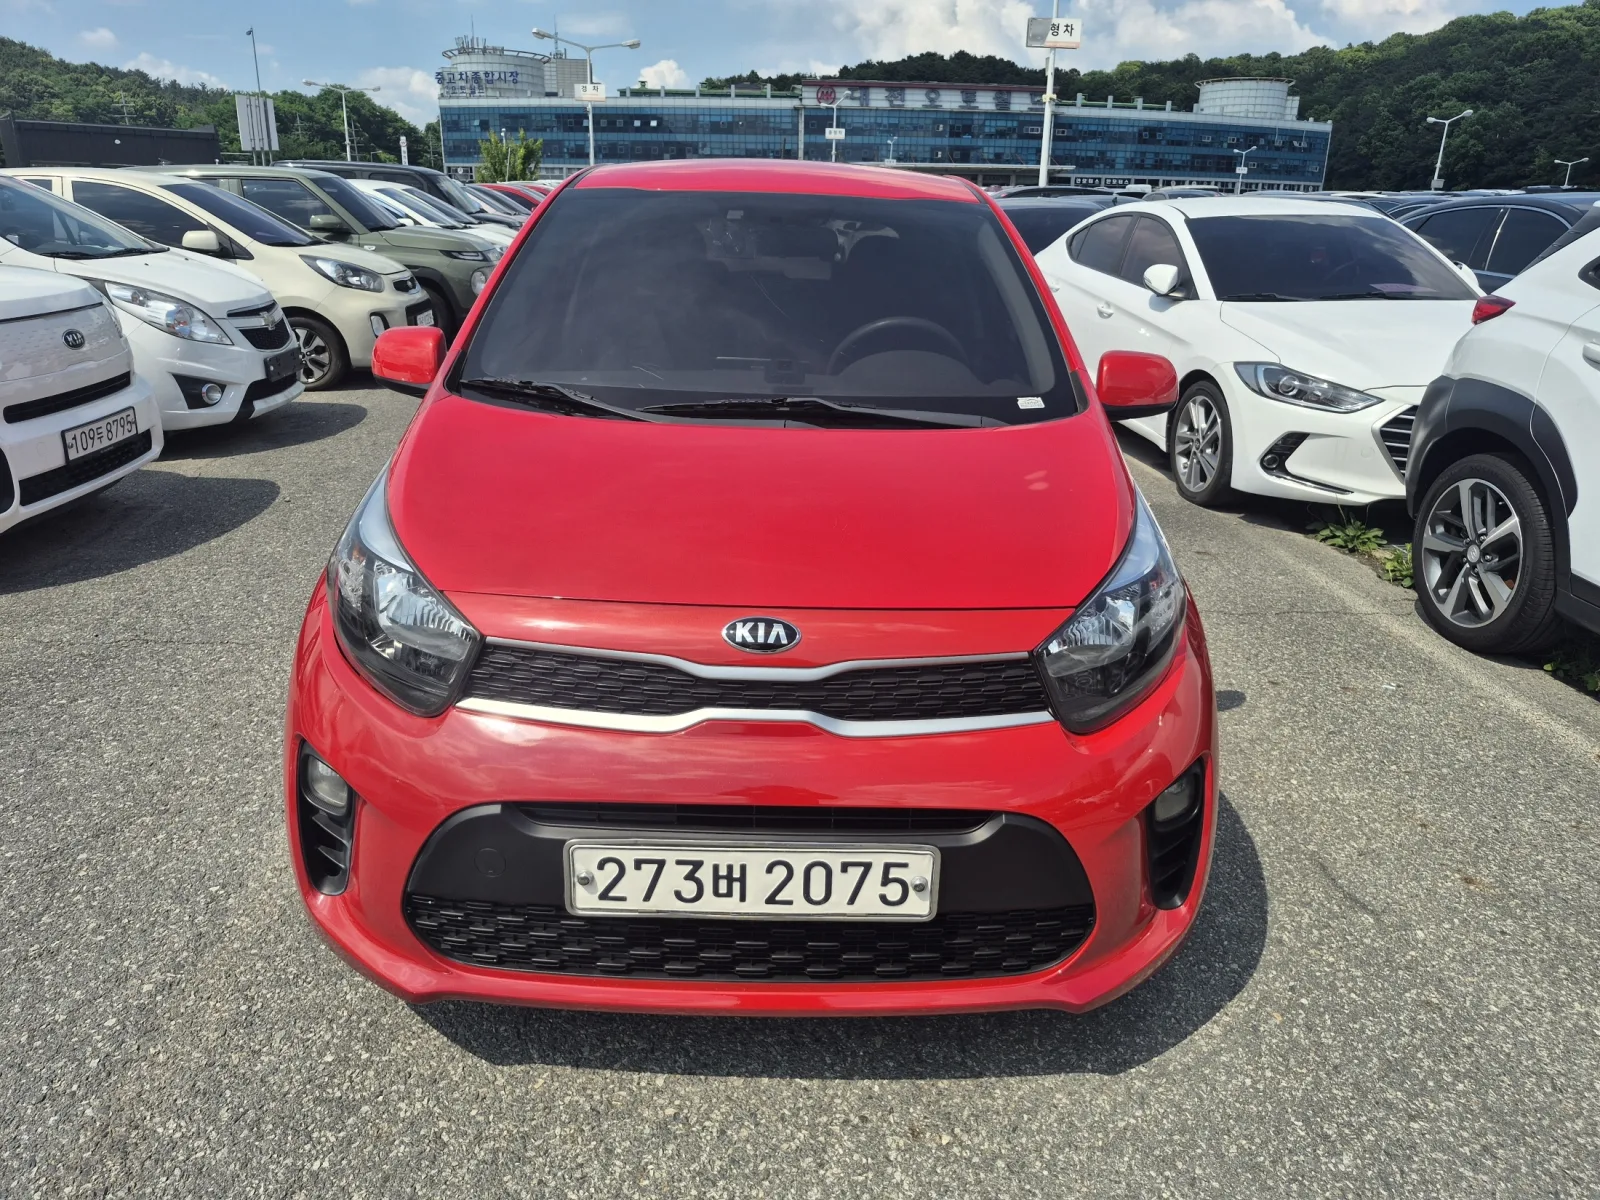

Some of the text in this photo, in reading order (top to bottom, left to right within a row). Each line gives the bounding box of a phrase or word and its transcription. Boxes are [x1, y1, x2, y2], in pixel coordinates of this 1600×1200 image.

[435, 71, 519, 84] 중고차종합시장
[66, 333, 84, 346] KIA
[72, 414, 133, 454] 109두 8795
[735, 622, 788, 646] KIA
[596, 856, 911, 907] 273버 2075
